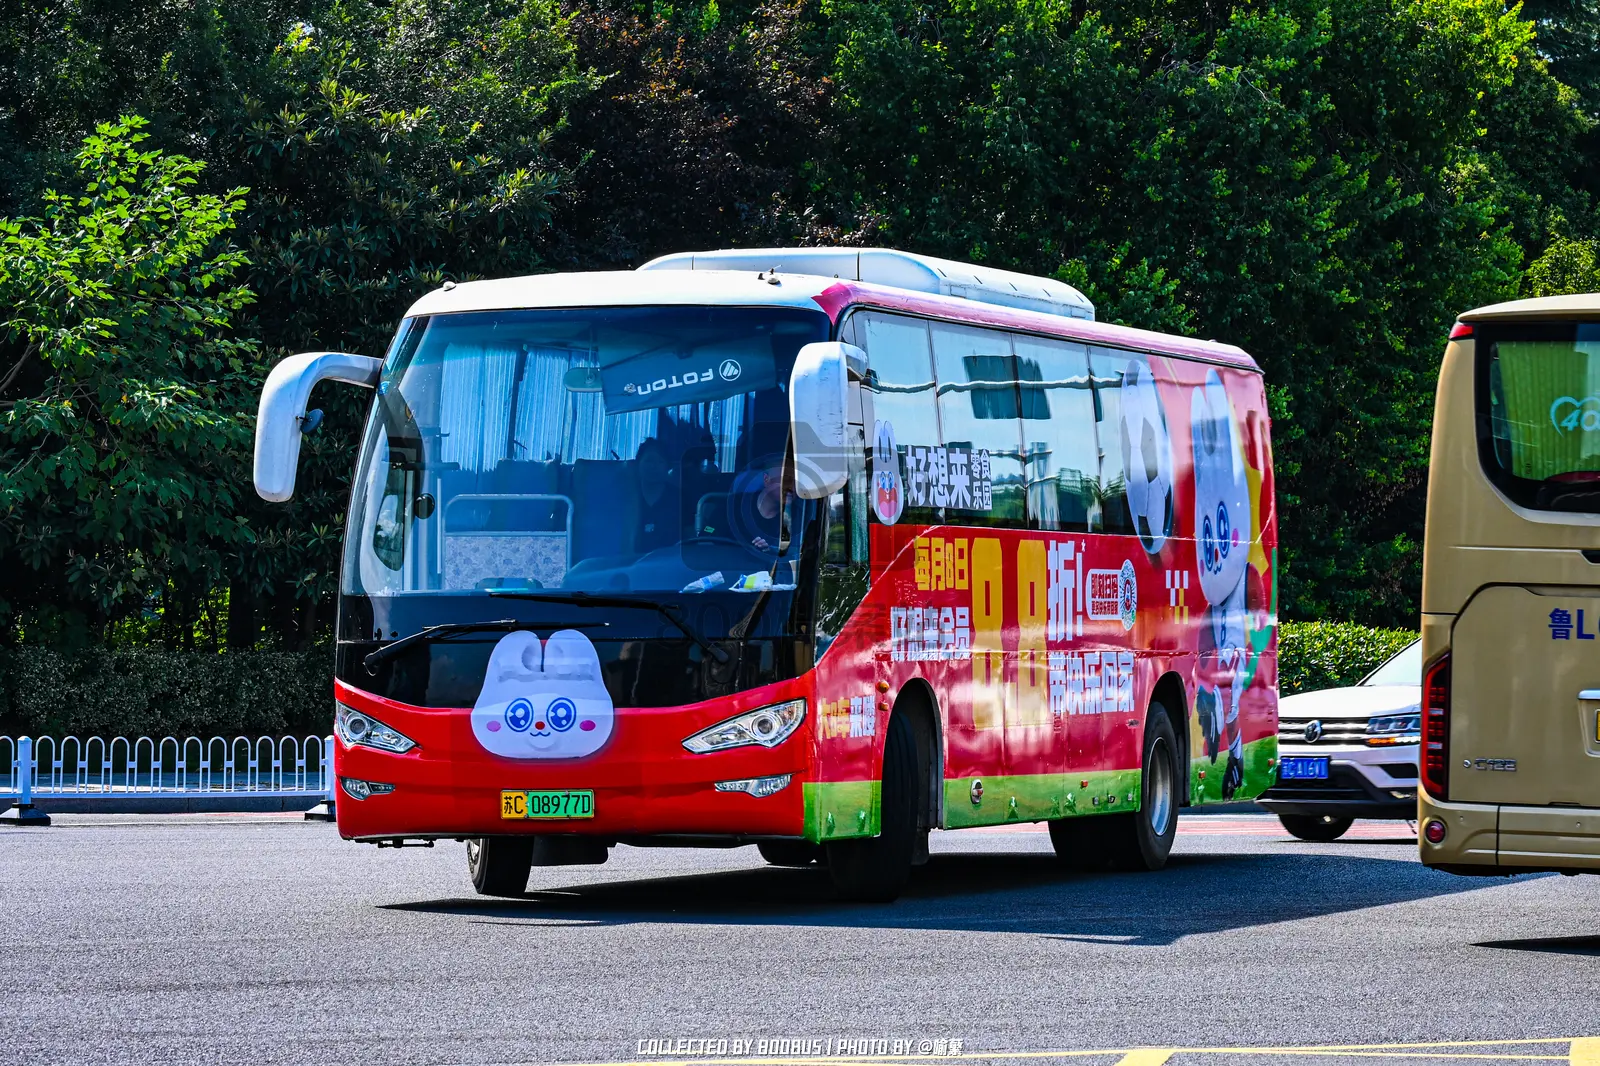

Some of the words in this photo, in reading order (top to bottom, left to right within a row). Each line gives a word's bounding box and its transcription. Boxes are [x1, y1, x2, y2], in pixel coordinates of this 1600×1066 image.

[637, 368, 714, 396] FOTON
[905, 445, 971, 509] 好想来
[971, 448, 991, 480] 零食
[972, 480, 992, 510] 乐园
[914, 536, 969, 591] 每月8日
[1548, 607, 1600, 640] 鲁L
